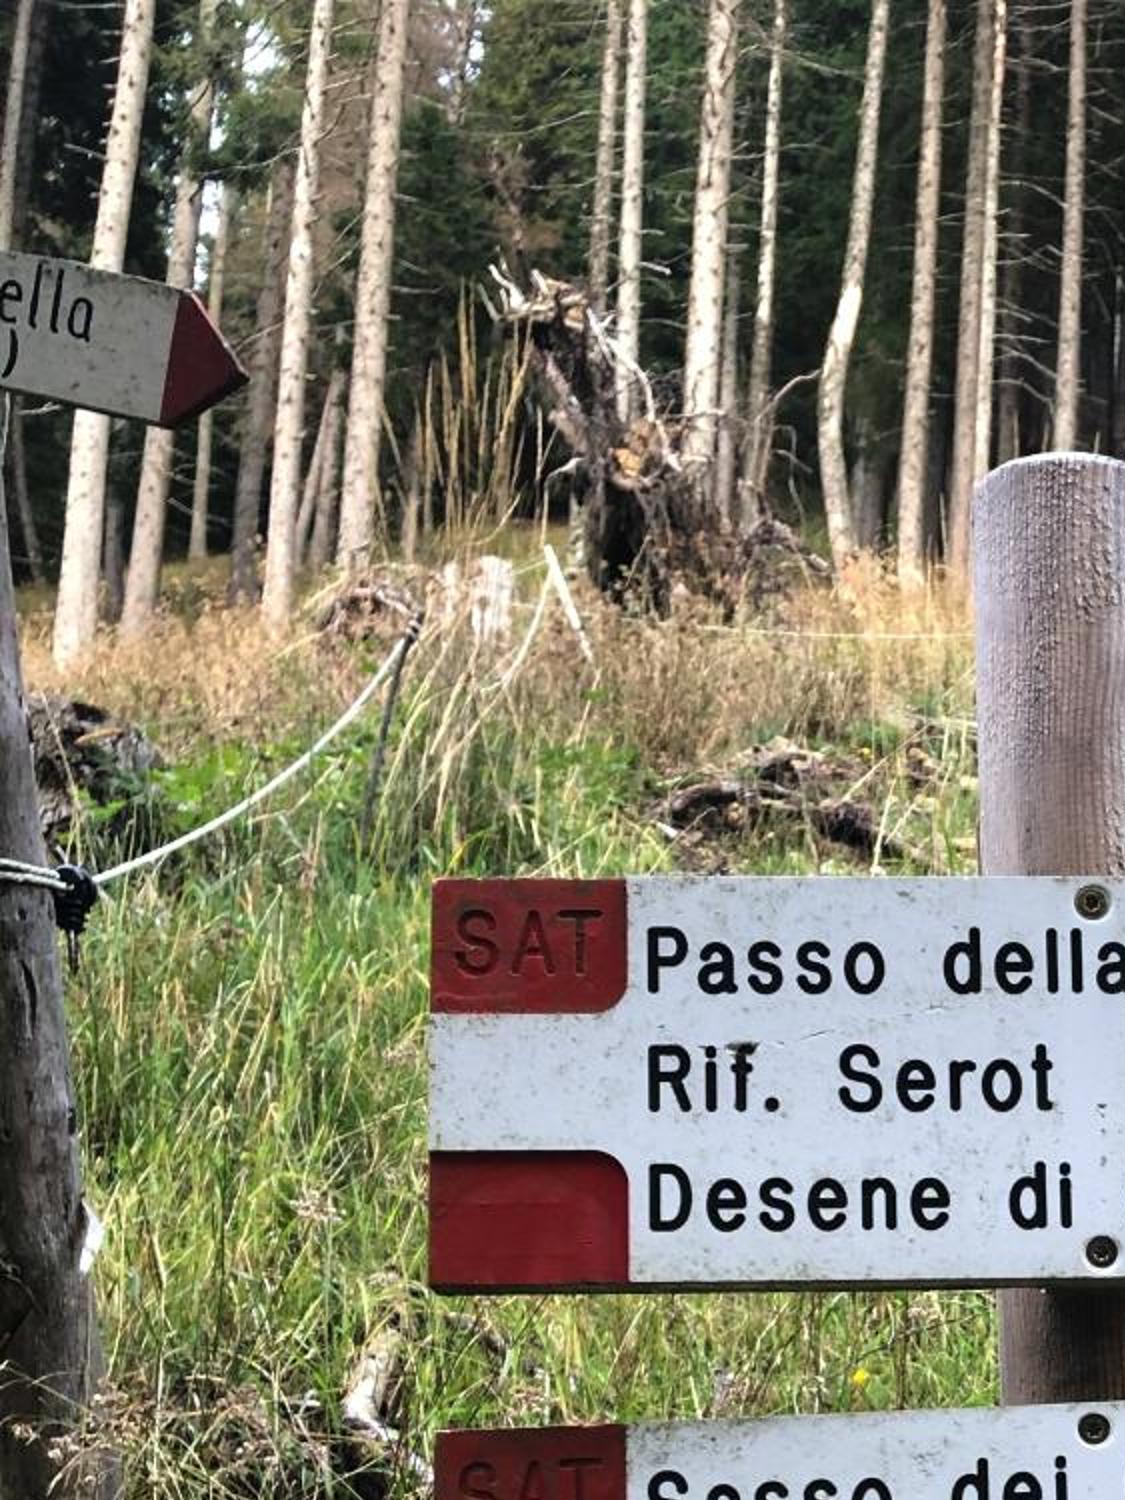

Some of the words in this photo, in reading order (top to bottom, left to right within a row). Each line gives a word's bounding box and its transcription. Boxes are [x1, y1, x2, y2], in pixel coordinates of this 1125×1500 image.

[455, 909, 604, 977] SAT
[647, 926, 885, 995] Passo
[647, 1042, 780, 1113] Rif.
[838, 1043, 1054, 1113] Serot
[649, 1163, 951, 1233] Desene
[1009, 1161, 1073, 1231] di
